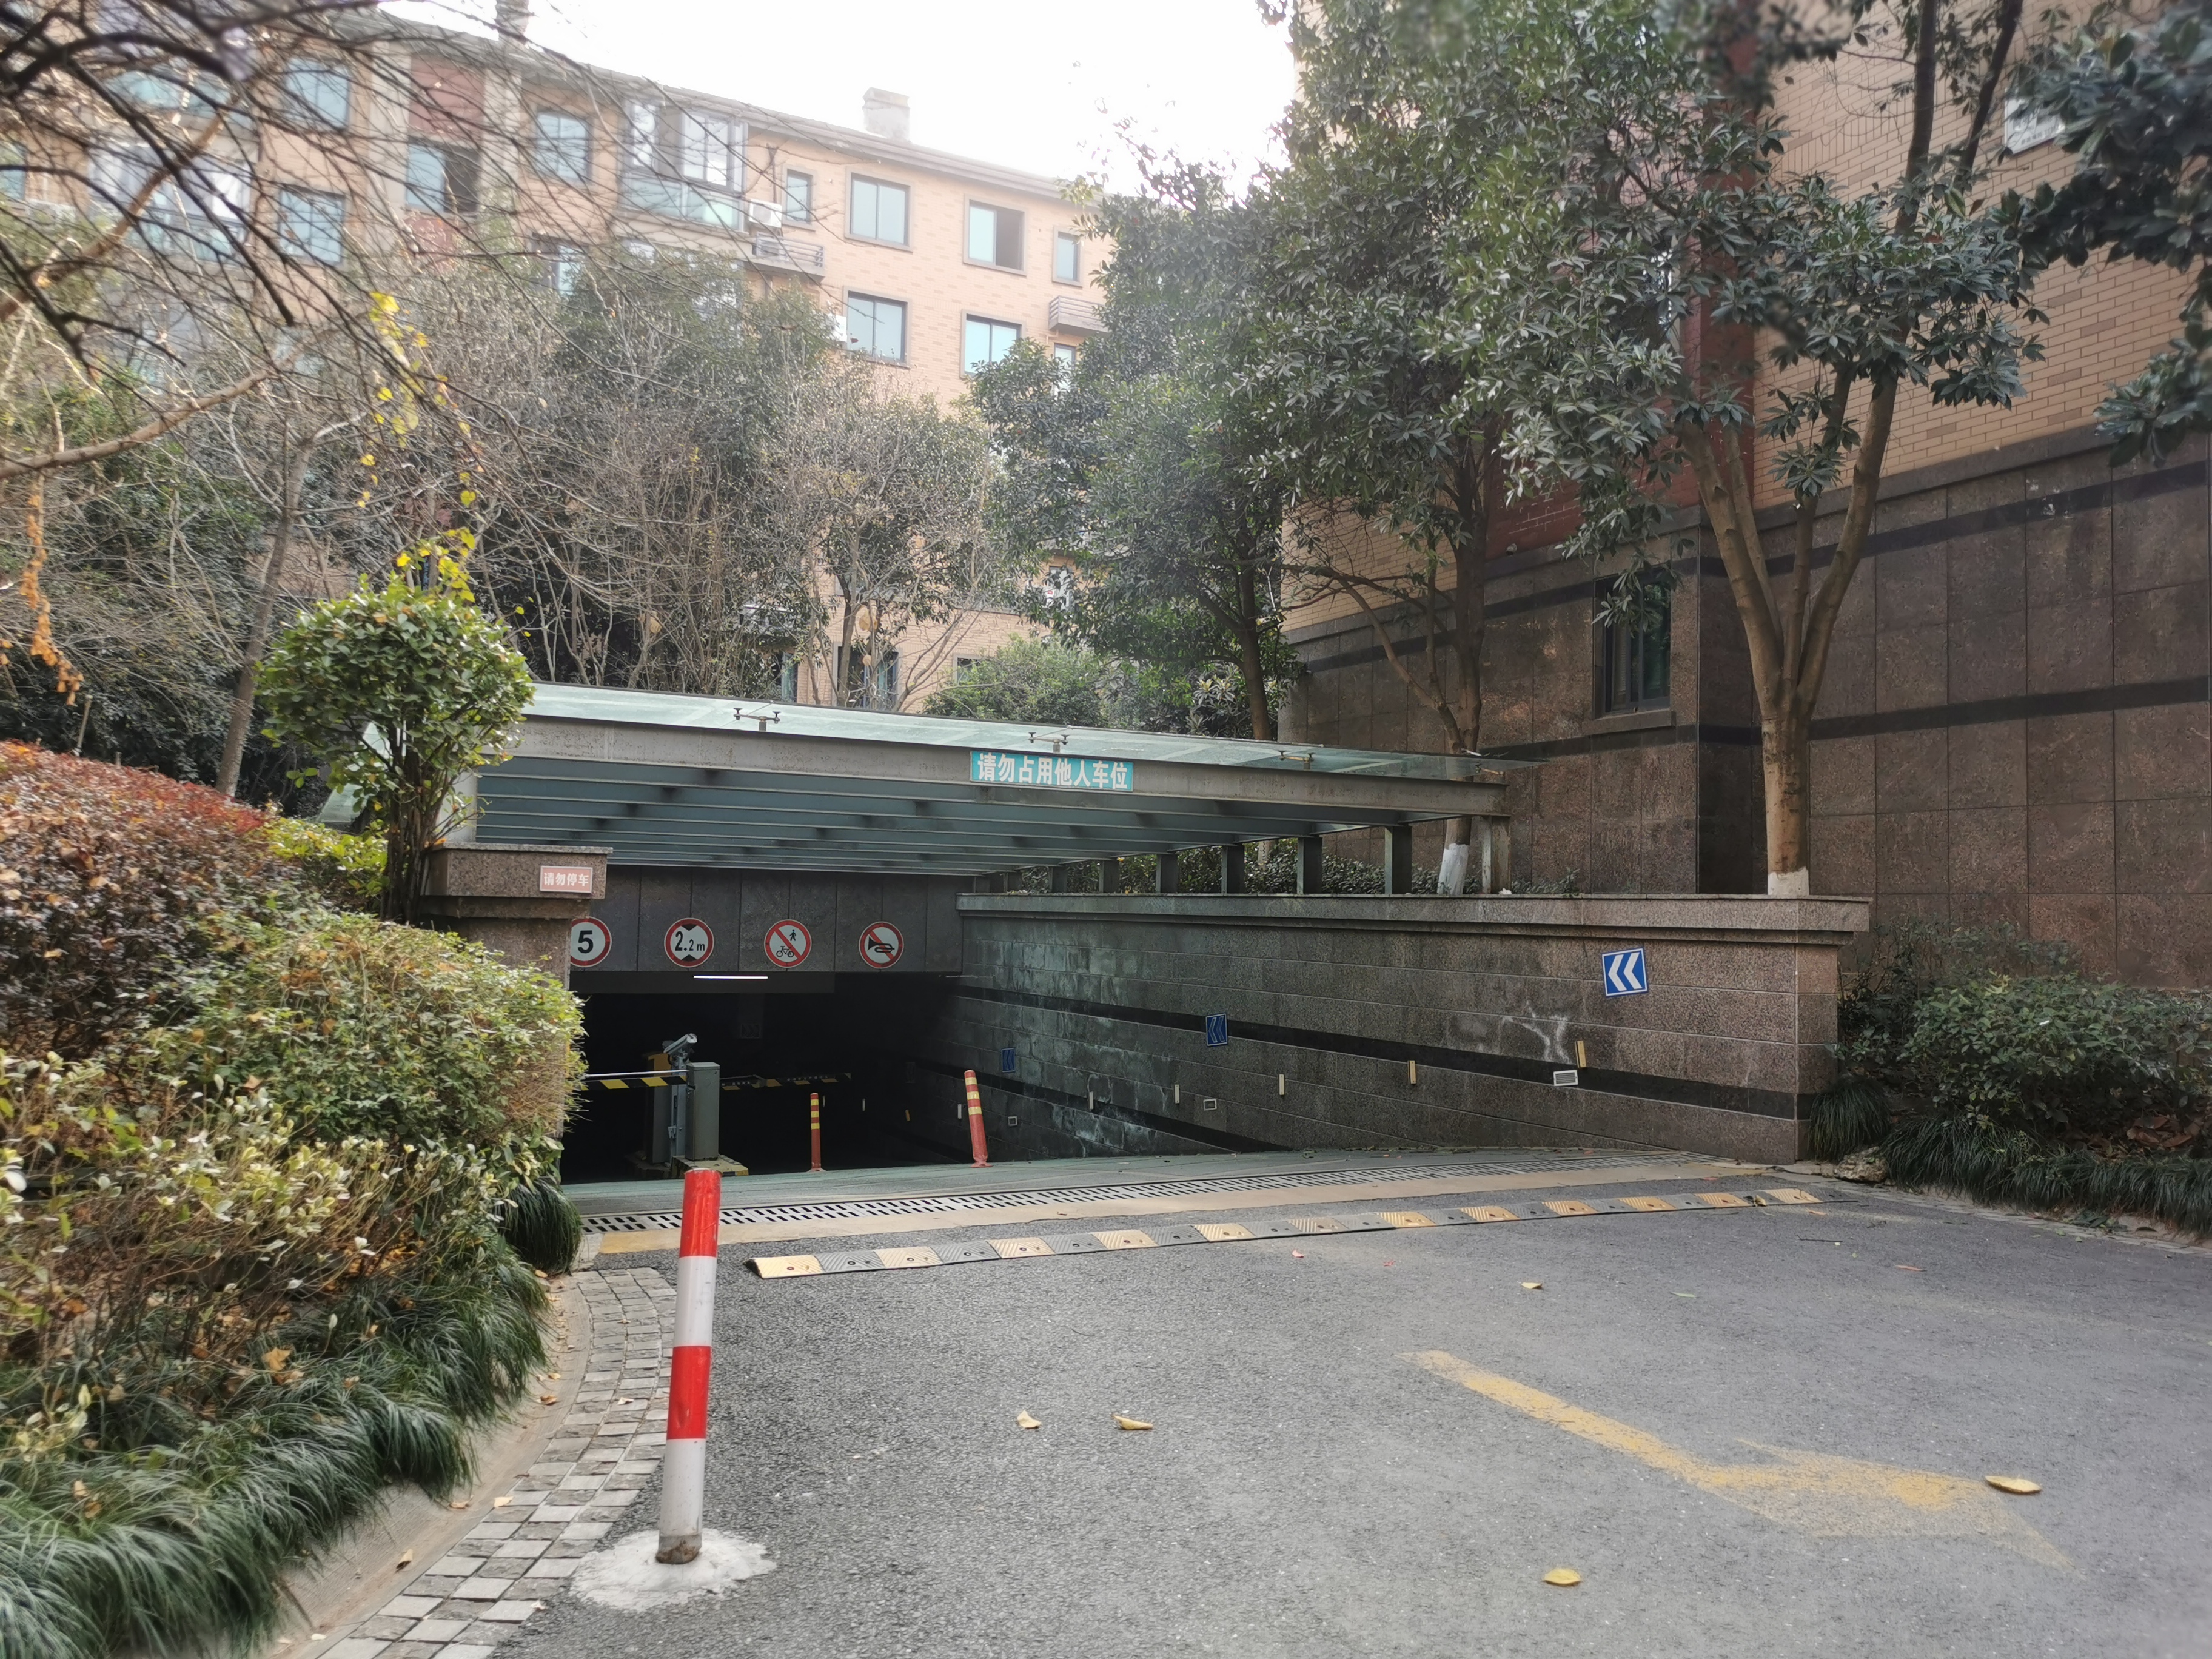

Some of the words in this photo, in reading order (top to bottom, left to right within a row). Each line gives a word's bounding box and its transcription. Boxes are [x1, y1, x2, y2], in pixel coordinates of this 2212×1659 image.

[977, 752, 1128, 789] 请勿占用他人车位
[543, 872, 589, 887] 请勿停车
[577, 930, 594, 954] 5
